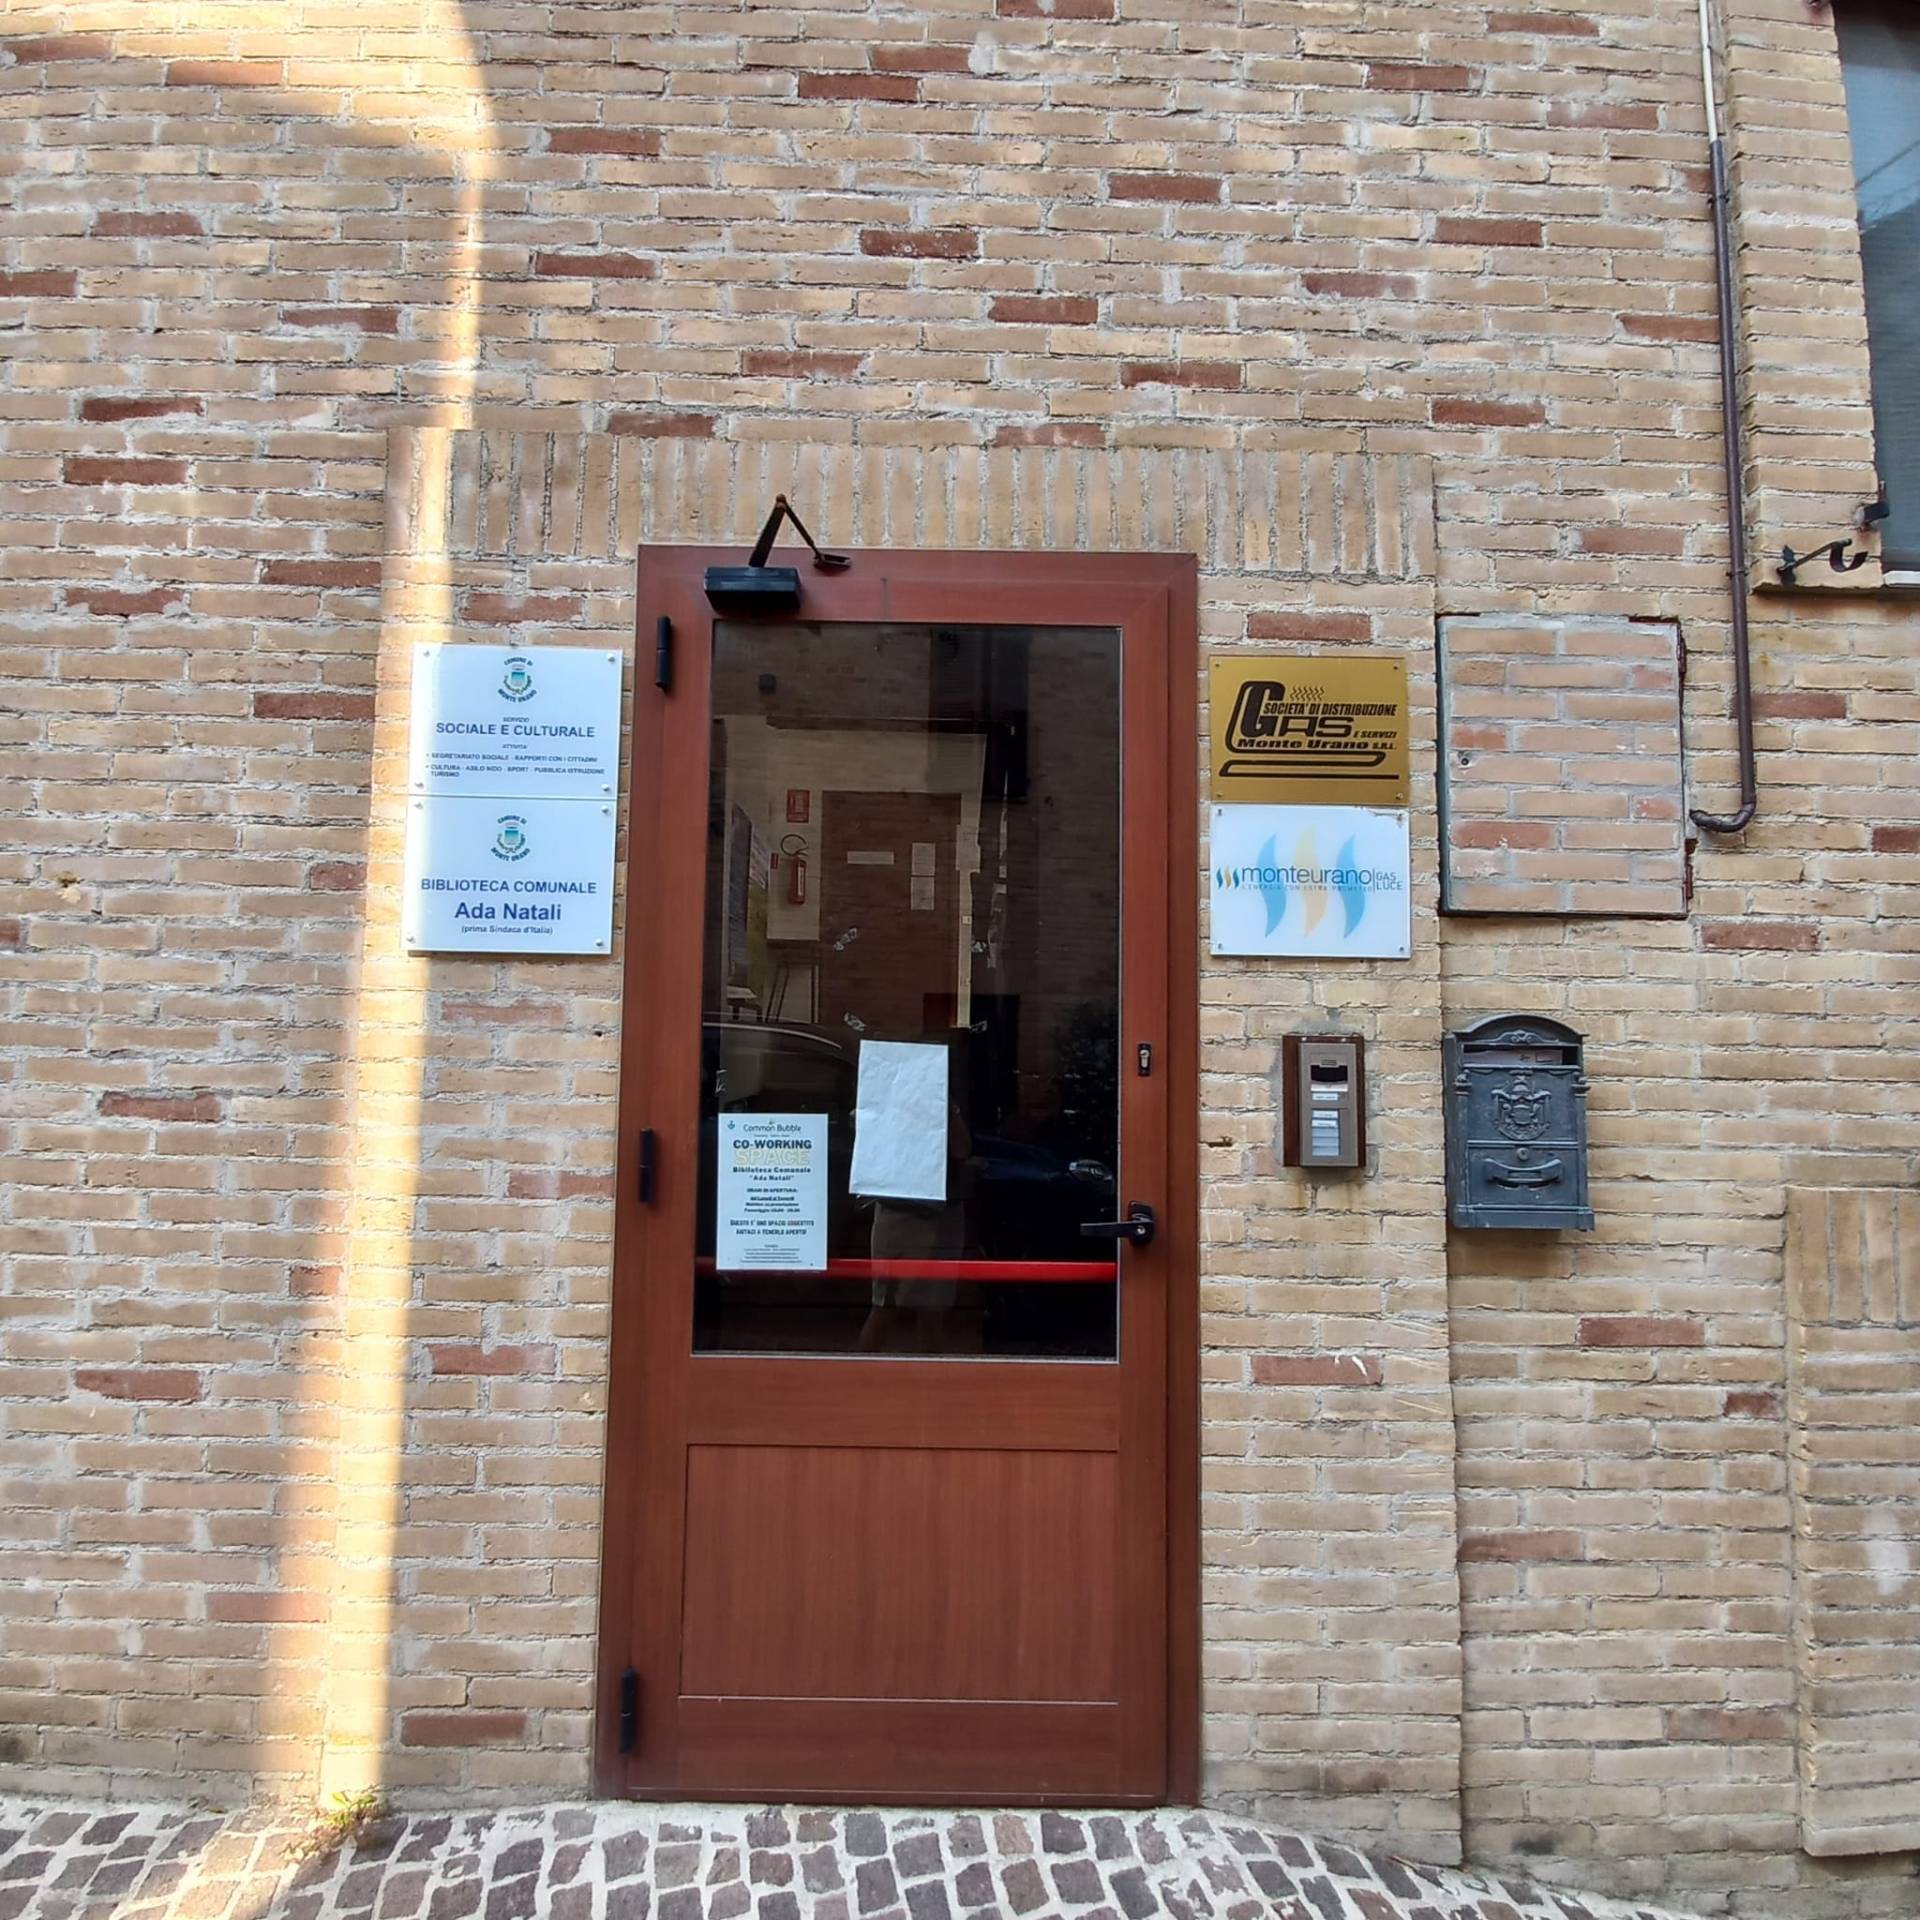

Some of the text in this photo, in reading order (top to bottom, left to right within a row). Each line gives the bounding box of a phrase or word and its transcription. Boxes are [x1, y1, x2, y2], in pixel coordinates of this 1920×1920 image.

[1240, 681, 1354, 738] GAS
[1309, 703, 1320, 715] DI
[1321, 703, 1397, 716] DISTRIBUZIONE
[436, 722, 596, 738] SOCIALE E CULTURALE
[1237, 738, 1302, 748] Monte
[1306, 739, 1369, 749] Urano
[431, 752, 480, 760] SEGRETARIATO
[1241, 865, 1372, 886] monteurano
[1376, 872, 1397, 881] GAS
[421, 878, 597, 894] BIBLIOTECA COMUNALE
[1377, 880, 1402, 891] LUCE
[454, 902, 562, 920] Ada Natali
[461, 925, 553, 935] (prima Sindaca d'Italia)
[743, 1124, 802, 1132] Common Bubble
[733, 1139, 812, 1149] CO-WORKING
[735, 1149, 809, 1166] SPACE
